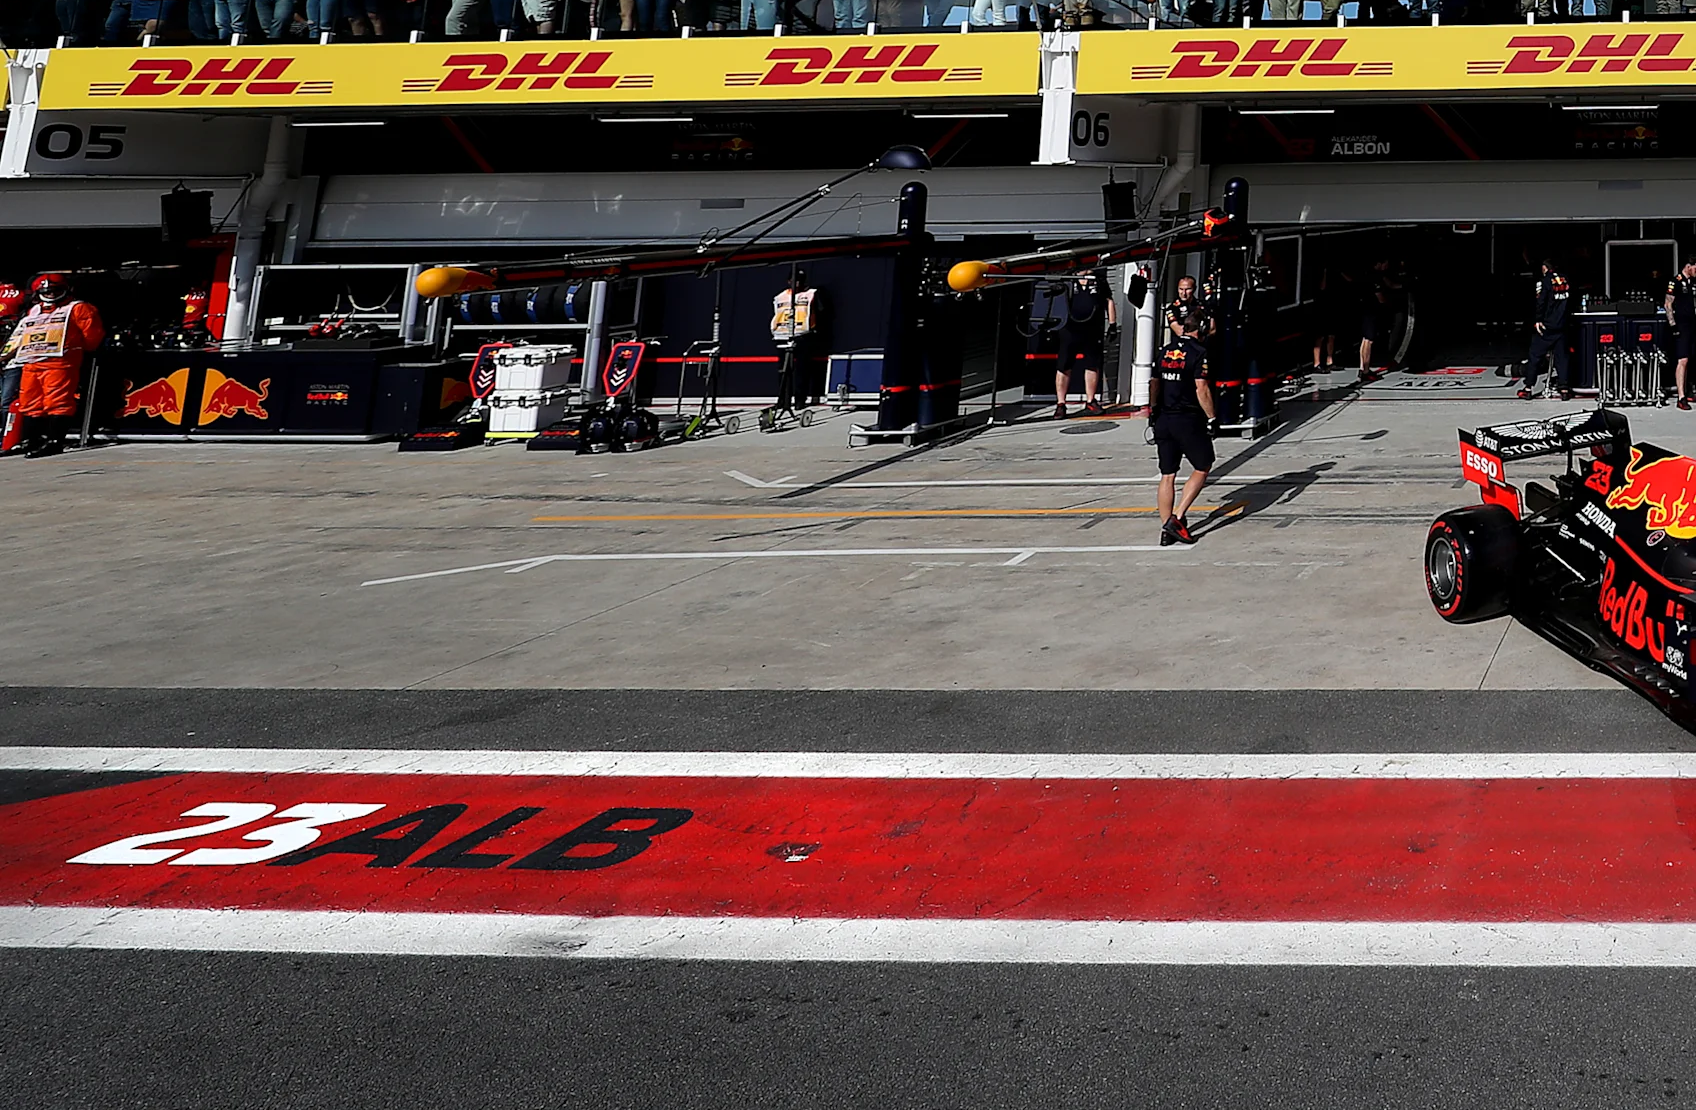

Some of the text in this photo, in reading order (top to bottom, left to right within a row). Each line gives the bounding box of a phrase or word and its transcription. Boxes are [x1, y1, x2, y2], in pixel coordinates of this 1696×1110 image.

[120, 57, 301, 95] DHL
[436, 52, 618, 92] DHL
[760, 44, 948, 84] DHL
[1166, 38, 1360, 78] DHL
[34, 123, 127, 161] 05
[1071, 109, 1110, 148] 06
[1331, 142, 1391, 155] ALBON
[1466, 450, 1498, 479] ESSO
[1501, 440, 1550, 456] STON
[1585, 460, 1613, 495] 23
[1581, 501, 1616, 539] HONDA
